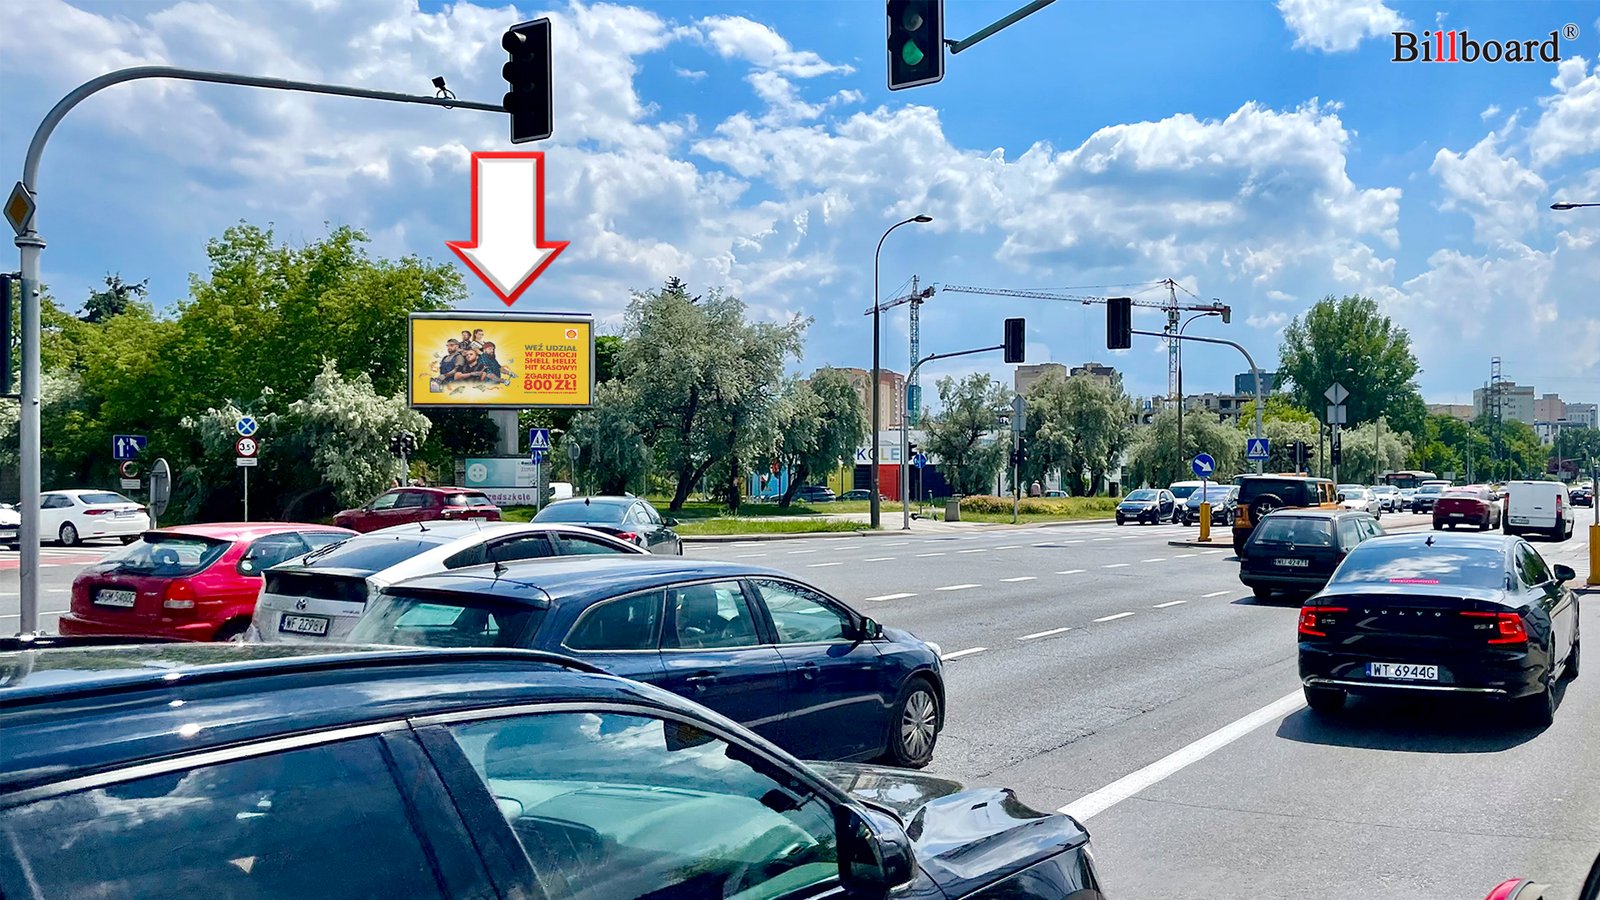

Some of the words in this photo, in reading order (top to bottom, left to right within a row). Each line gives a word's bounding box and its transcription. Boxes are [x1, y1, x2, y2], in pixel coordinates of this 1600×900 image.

[523, 379, 553, 391] 800
[554, 379, 577, 391] ZŁ!
[488, 493, 531, 501] zedszkole
[1364, 608, 1441, 617] VOLVO
[1374, 664, 1389, 676] WT
[1395, 665, 1435, 679] 6944G
